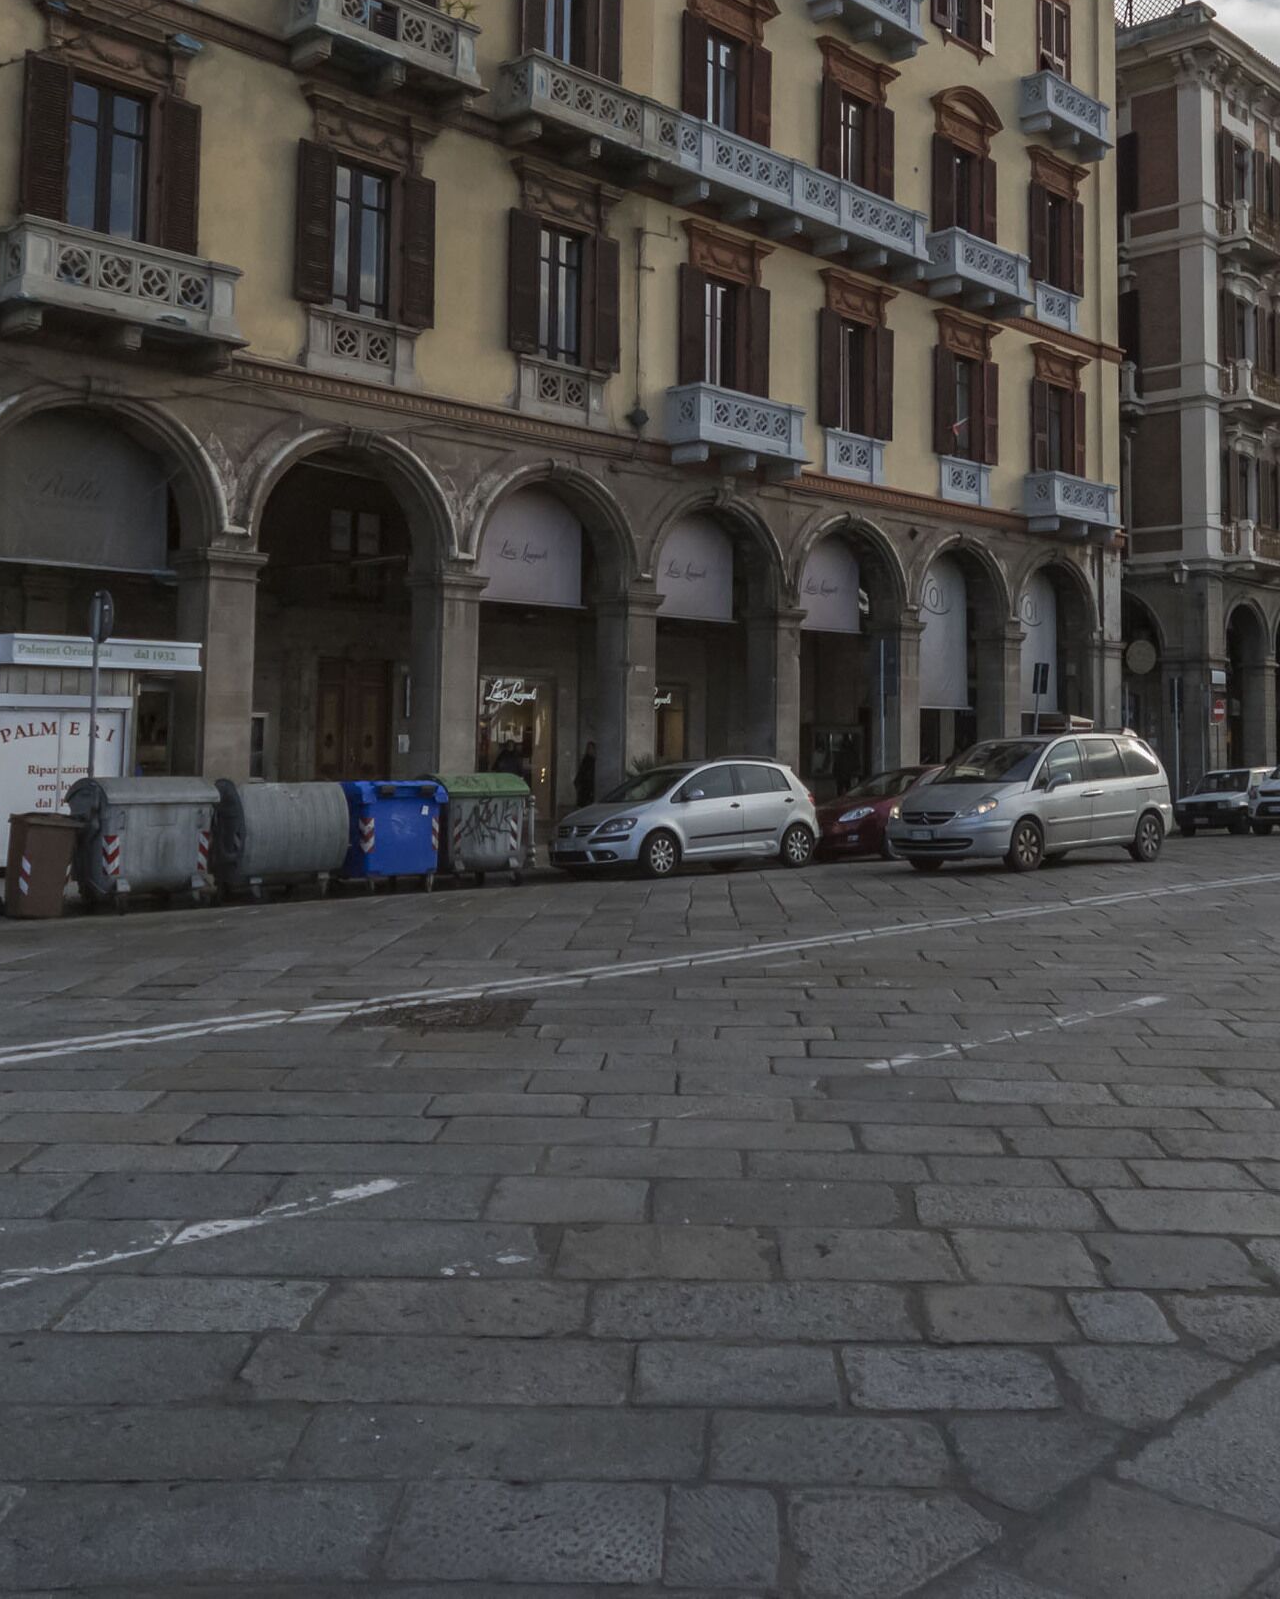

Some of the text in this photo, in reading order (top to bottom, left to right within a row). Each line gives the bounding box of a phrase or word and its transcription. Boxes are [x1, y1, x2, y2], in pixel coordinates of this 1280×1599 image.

[18, 643, 61, 655] Palmeri
[134, 648, 149, 659] dal
[152, 649, 177, 661] 1932
[28, 765, 90, 777] Riparazion
[35, 798, 52, 808] dal
